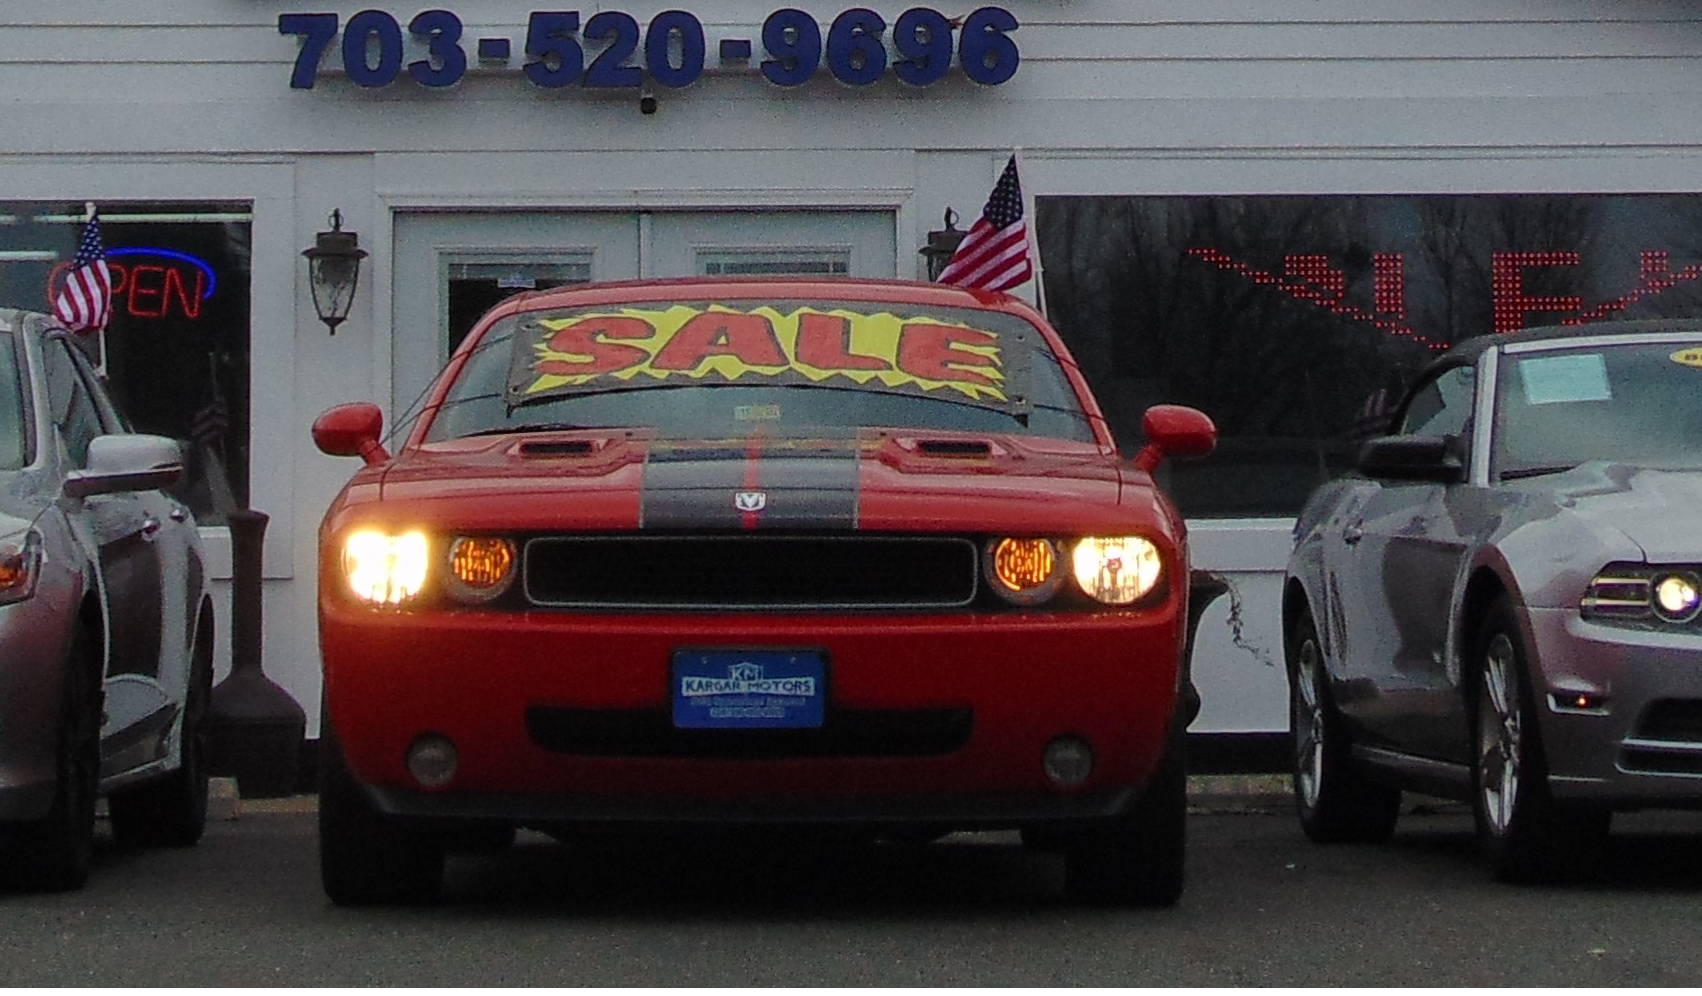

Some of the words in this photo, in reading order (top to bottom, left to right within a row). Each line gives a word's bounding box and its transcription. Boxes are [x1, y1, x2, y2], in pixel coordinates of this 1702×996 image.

[278, 6, 1020, 89] 703-520-9696
[533, 310, 999, 385] SALE
[685, 680, 741, 693] KARGAR
[747, 680, 811, 693] MOTORS
